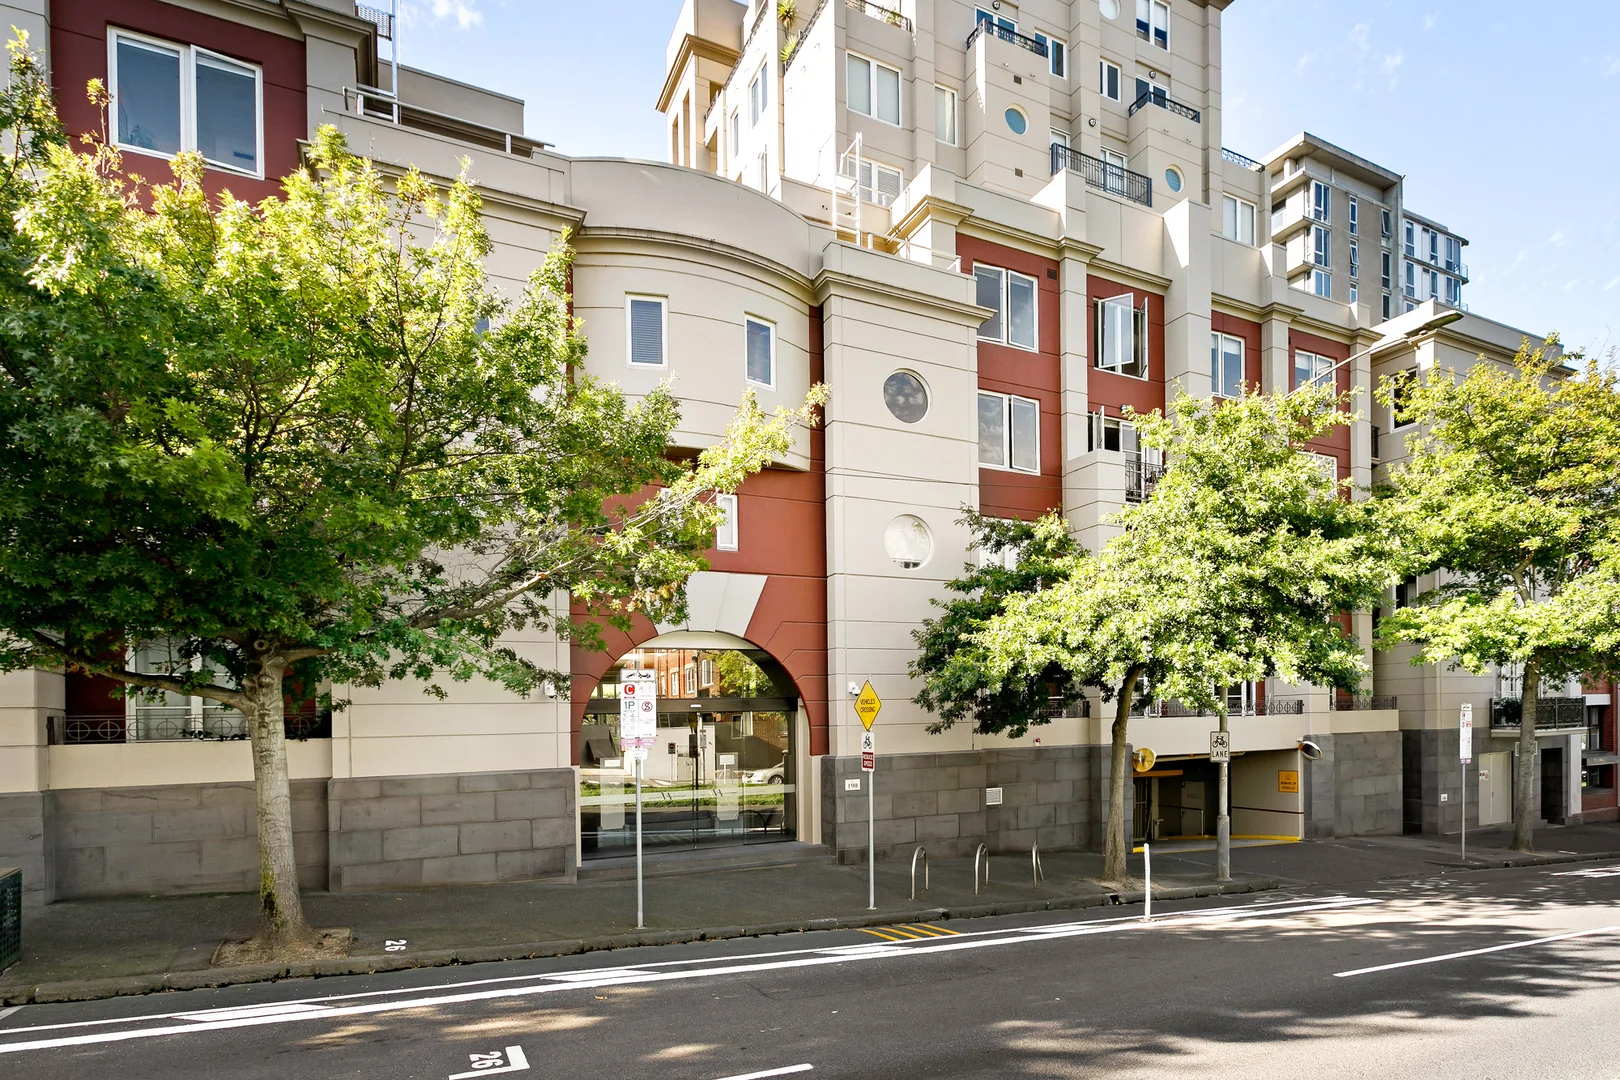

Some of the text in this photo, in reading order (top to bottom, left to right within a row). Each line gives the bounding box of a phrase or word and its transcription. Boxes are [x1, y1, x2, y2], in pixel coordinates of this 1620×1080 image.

[624, 701, 635, 710] 1P
[385, 939, 407, 952] 26
[469, 1051, 503, 1069] 26
